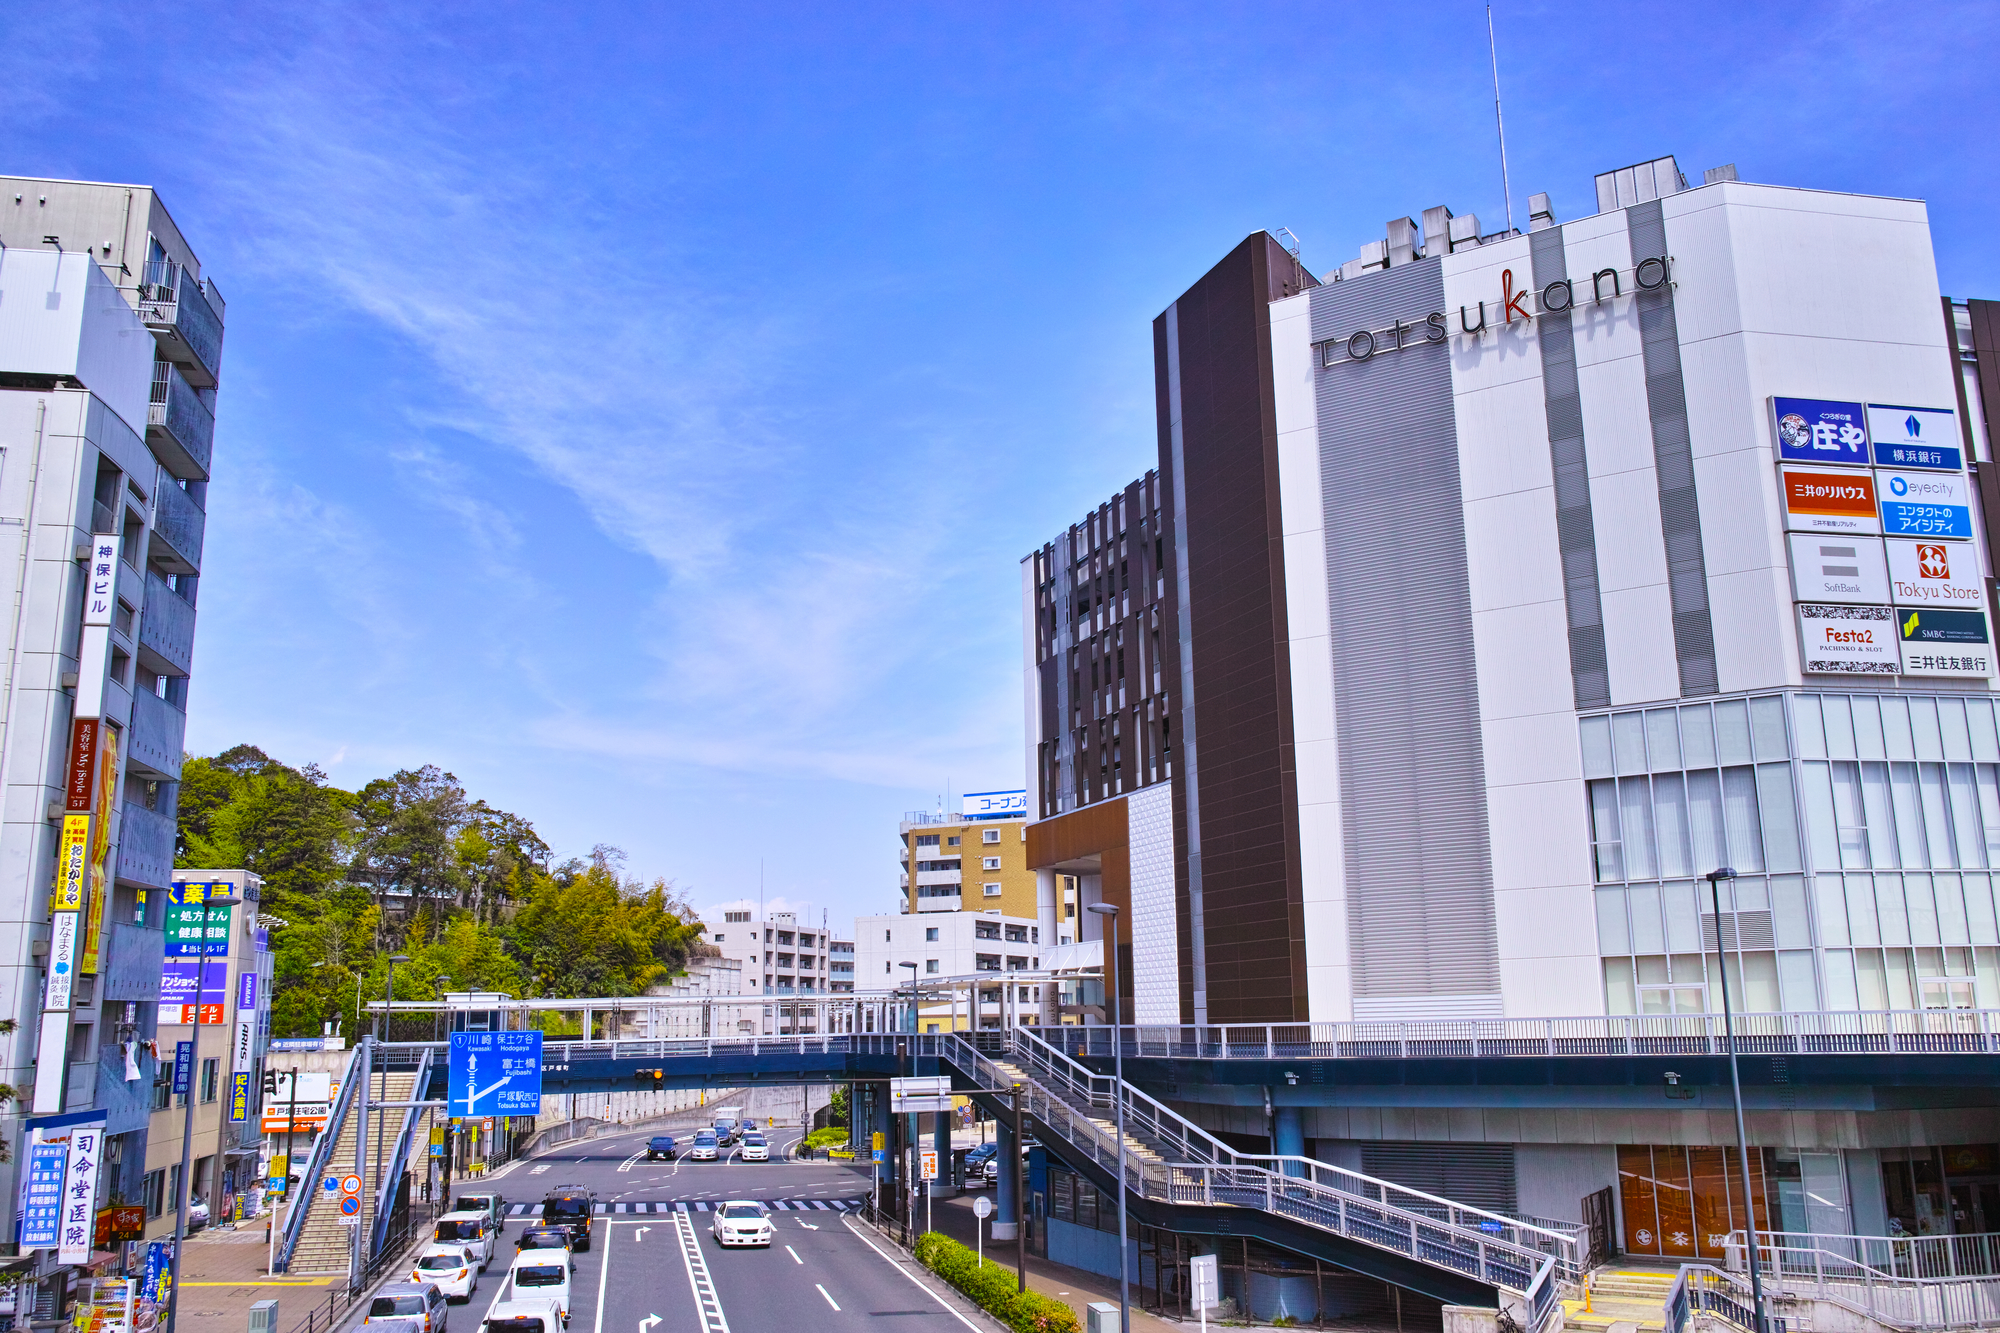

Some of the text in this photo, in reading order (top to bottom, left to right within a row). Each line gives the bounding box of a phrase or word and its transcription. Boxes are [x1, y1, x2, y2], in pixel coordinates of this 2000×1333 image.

[1811, 420, 1865, 453] 庄や
[1892, 449, 1942, 464] 横浜銀行
[1794, 484, 1866, 500] 三井のリハウス
[1908, 482, 1954, 498] eyecity
[1897, 505, 1953, 518] コンタクトの
[1898, 517, 1954, 533] アイシティ
[91, 545, 113, 613] 神保ビル
[1824, 583, 1862, 593] SoftBank
[1894, 581, 1980, 600] Tokyu Store
[1825, 627, 1874, 643] Festa2
[1921, 629, 1946, 639] SMBC
[1909, 655, 1987, 672] 三井住友銀行
[70, 818, 83, 826] 4F
[65, 844, 84, 906] おたからや
[180, 910, 228, 922] 処方せん
[57, 915, 74, 961] はなまる
[178, 926, 227, 939] 健康相談
[216, 945, 226, 953] 1F
[244, 974, 253, 1005] APAMAN
[468, 1034, 492, 1045] 川崎
[502, 1058, 537, 1069] 富士橋
[232, 1074, 248, 1120] 紀久薬局
[497, 1090, 539, 1102] 戸塚駅西口
[66, 1134, 95, 1247] 司命堂医院
[345, 1180, 358, 1190] 40
[27, 1207, 56, 1218] 皮膚科
[26, 1219, 55, 1230] 小児科
[339, 1217, 360, 1225] ここまで
